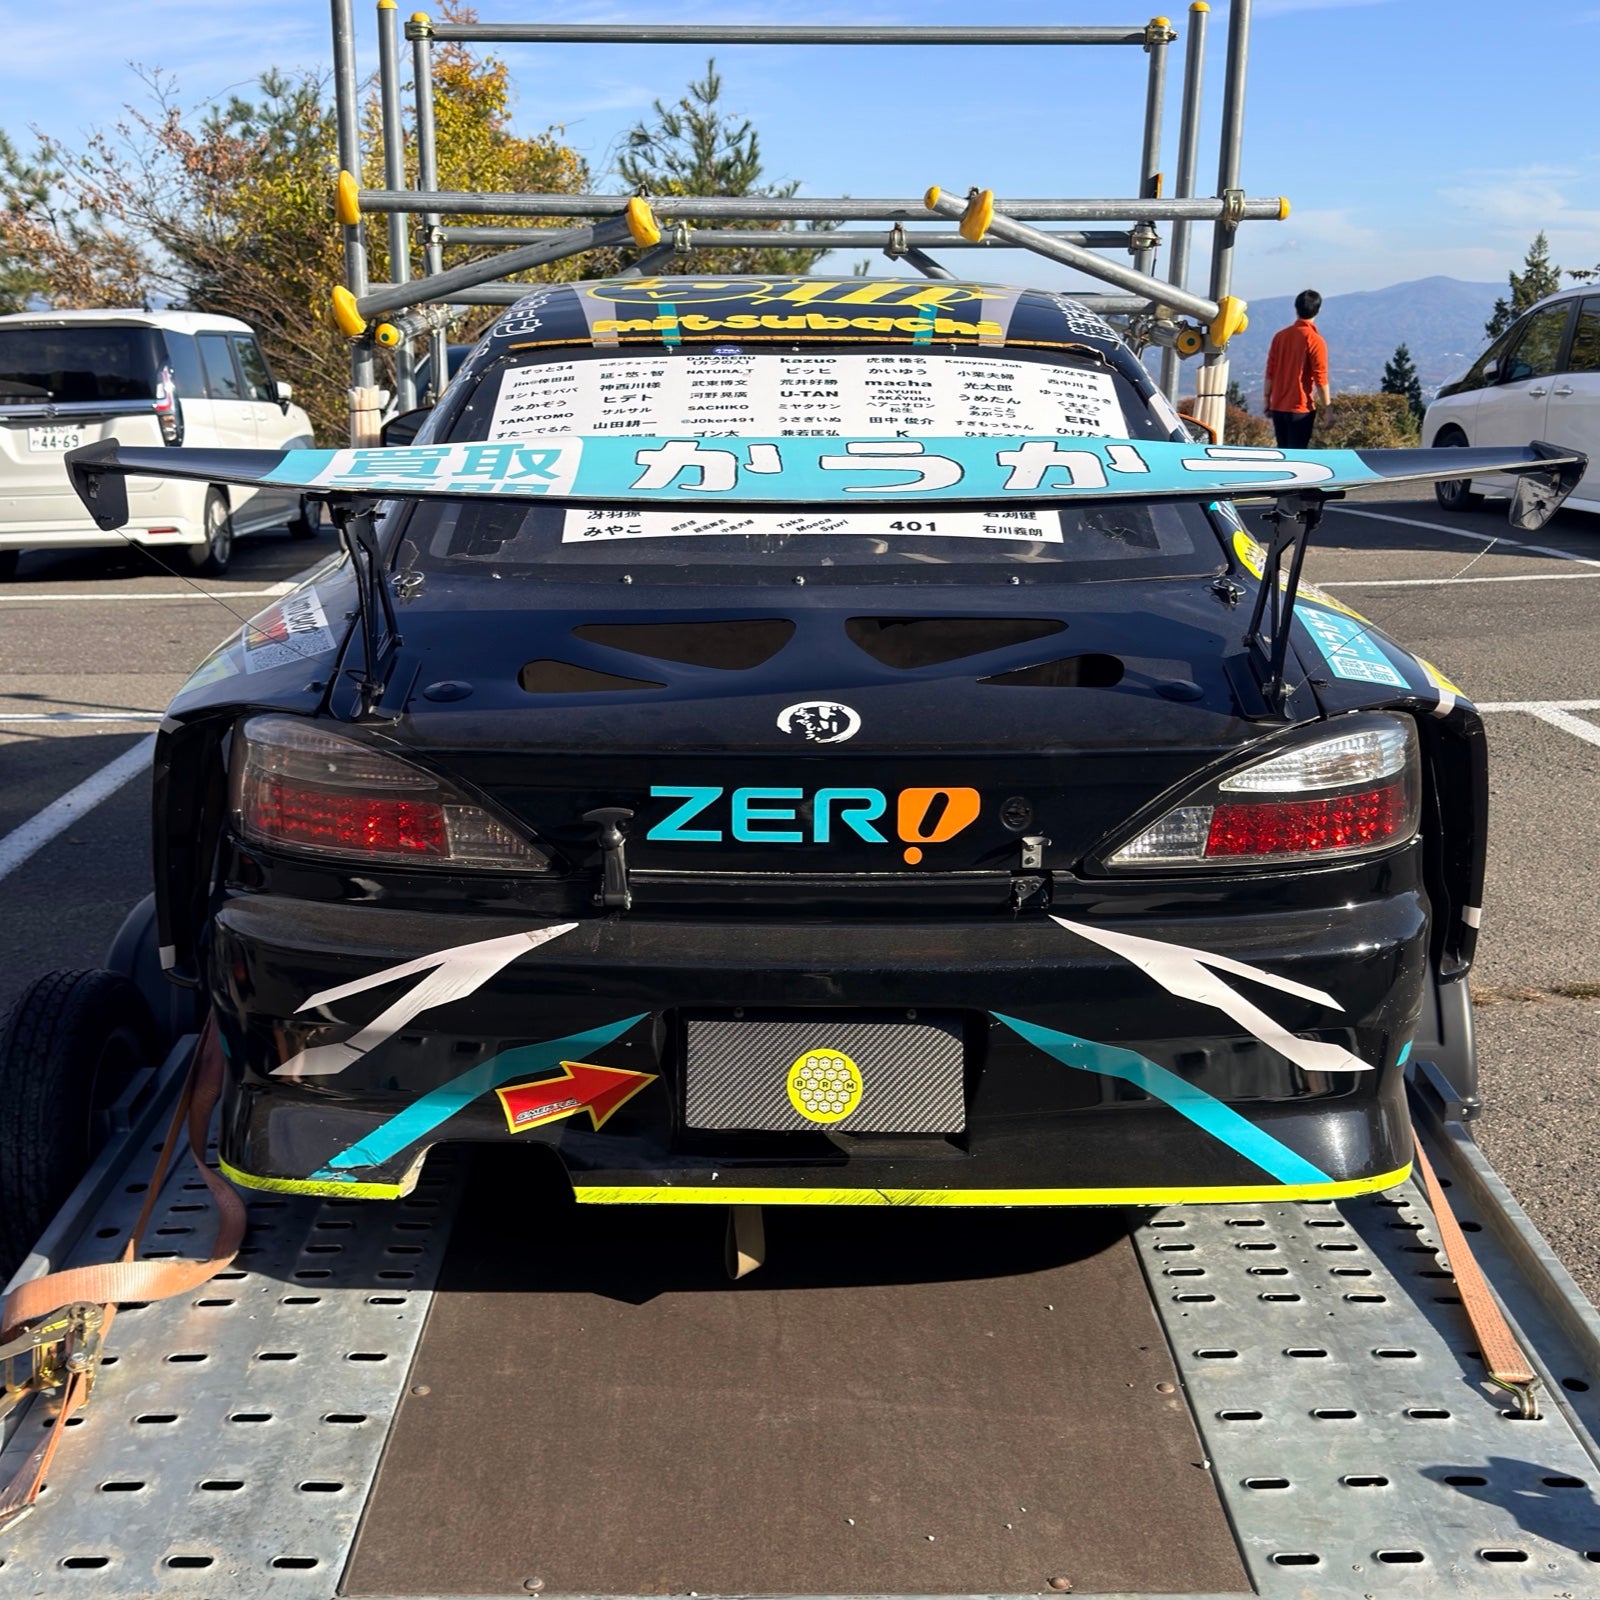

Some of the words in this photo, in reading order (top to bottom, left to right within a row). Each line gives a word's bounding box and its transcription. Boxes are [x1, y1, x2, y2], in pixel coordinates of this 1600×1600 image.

[592, 314, 1004, 336] mitsubachi
[963, 383, 1013, 392] 光太郎
[603, 394, 654, 404] ヒデト
[958, 394, 1022, 405] うめたん
[601, 407, 653, 416] サルサル
[498, 412, 575, 426] TAKATOMO
[593, 420, 658, 430] 山田耕一
[1064, 415, 1101, 428] ERI
[896, 430, 910, 438] K
[41, 434, 80, 449] 44-69
[334, 443, 563, 481] 買取
[629, 439, 1336, 493] かうかう
[776, 517, 806, 529] Taka
[796, 518, 832, 533] Moeca
[819, 519, 850, 533] Syuri
[889, 521, 937, 532] 401
[583, 524, 642, 537] みやこ
